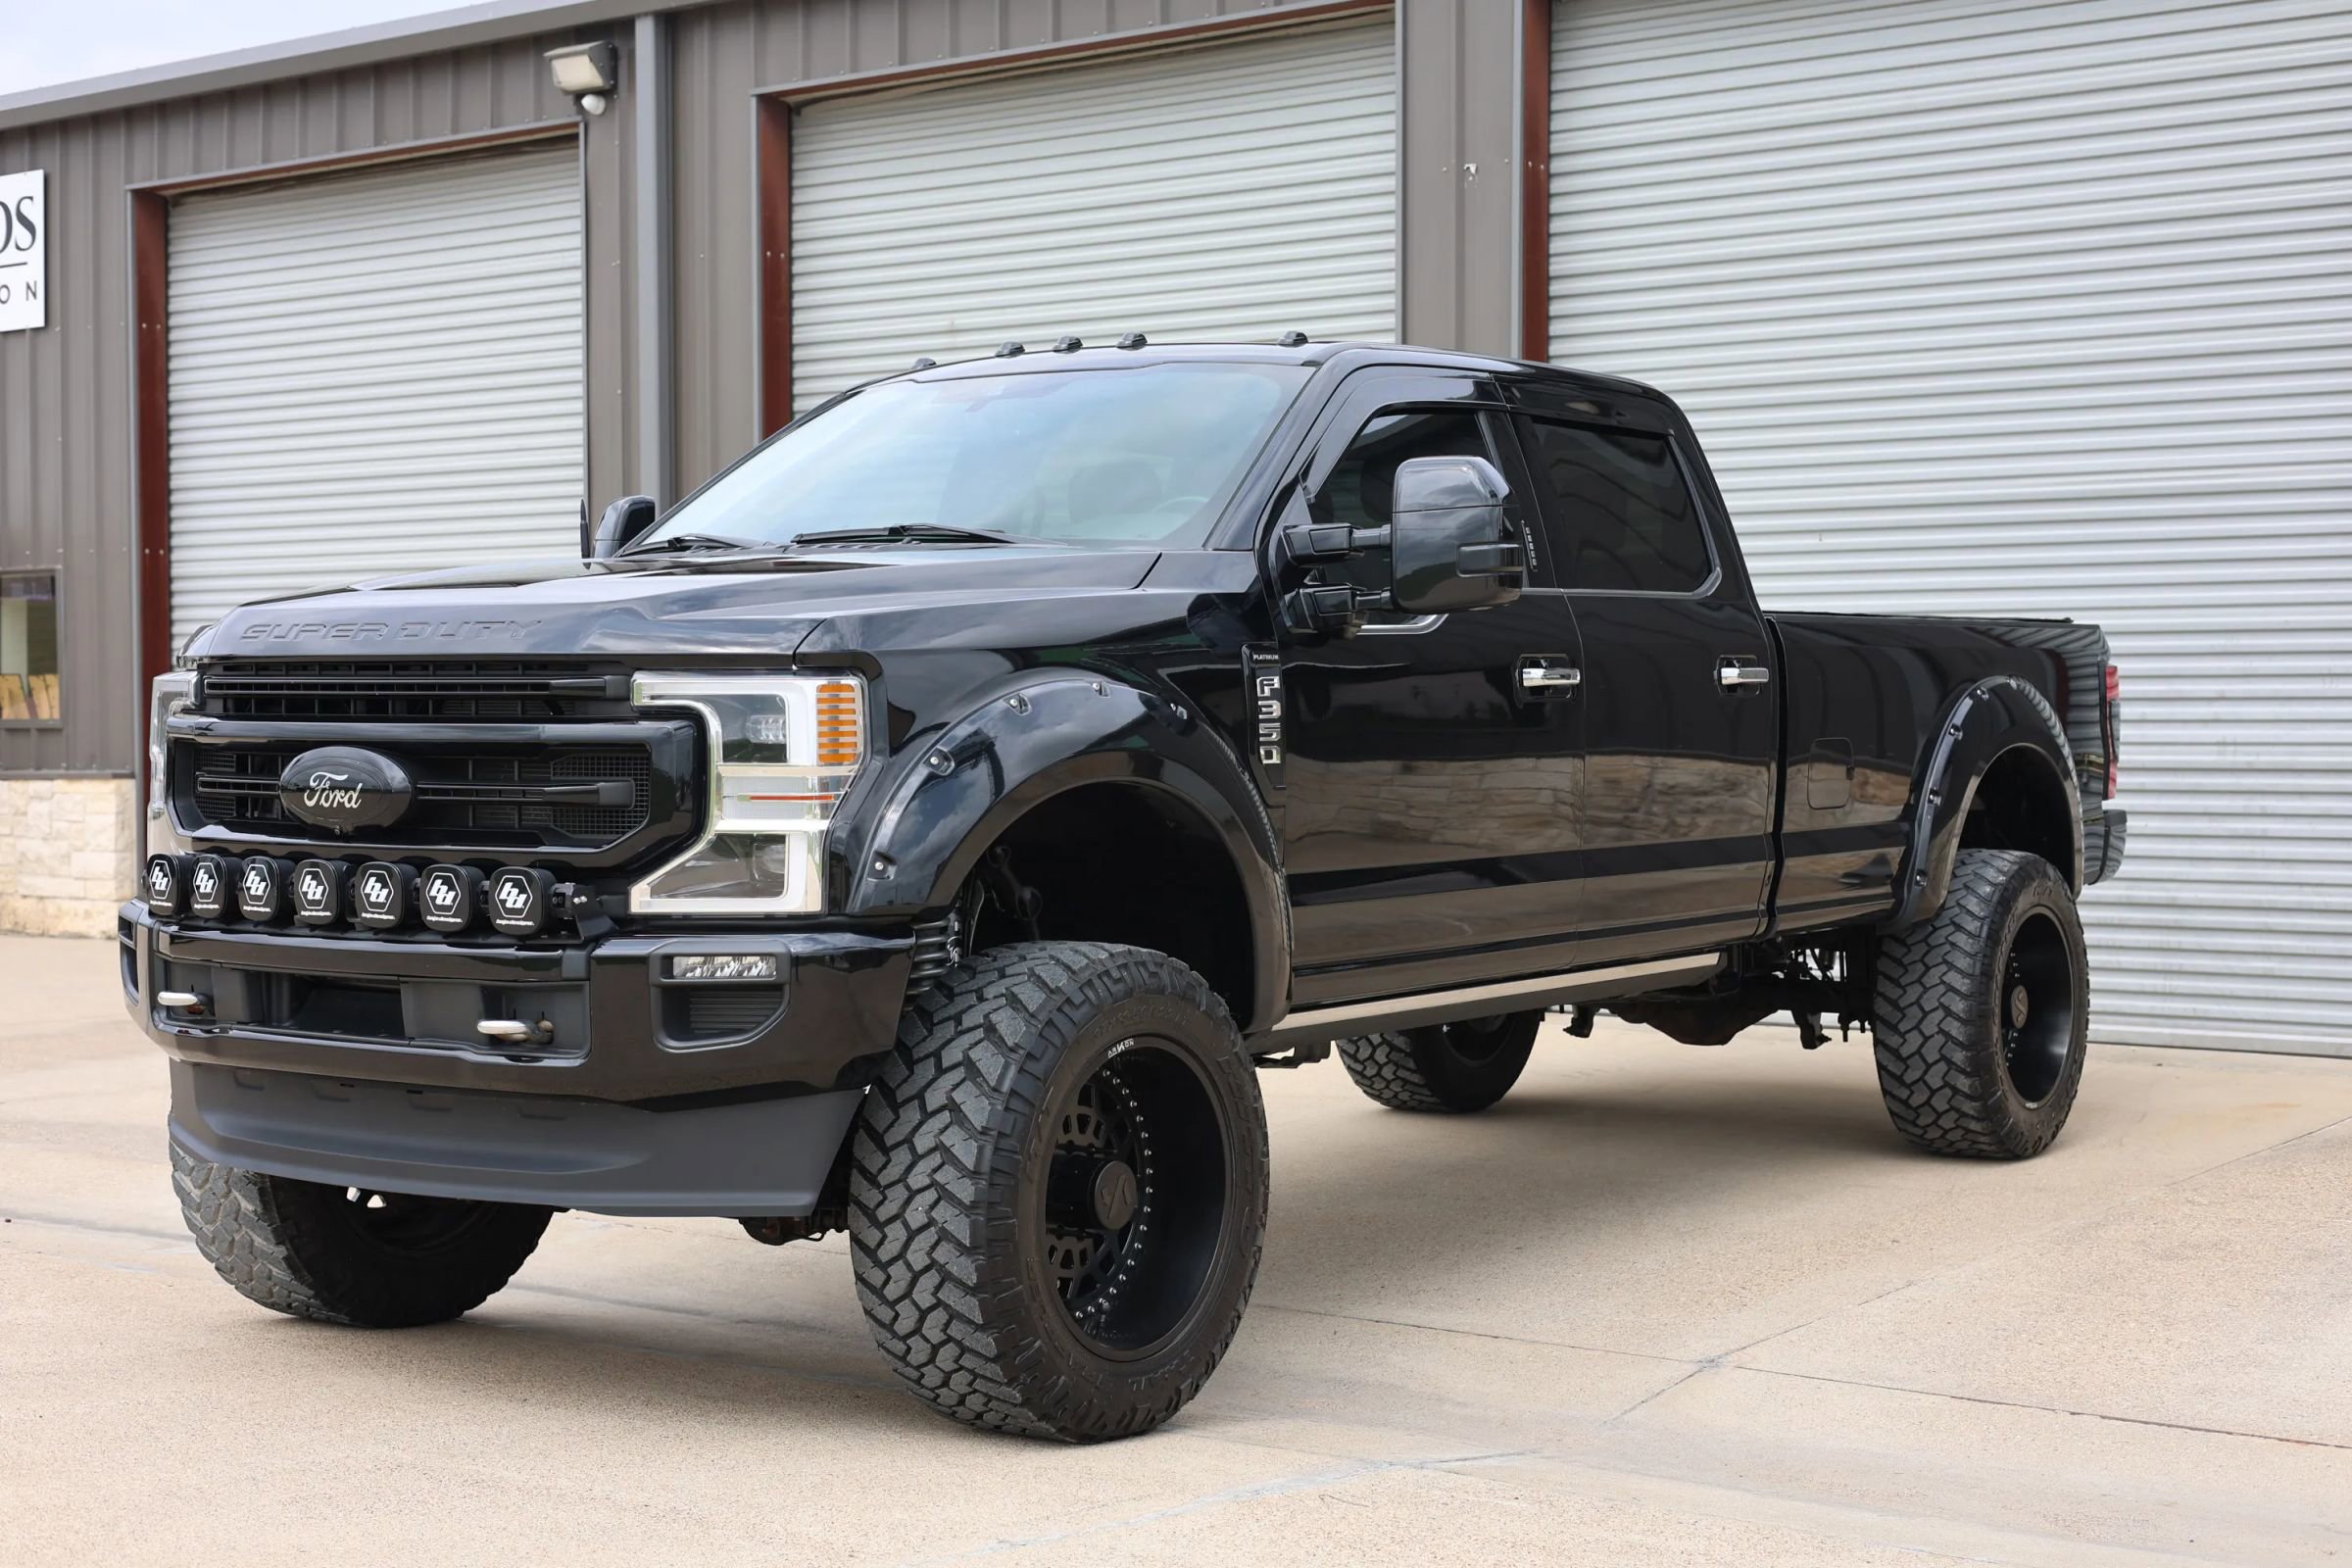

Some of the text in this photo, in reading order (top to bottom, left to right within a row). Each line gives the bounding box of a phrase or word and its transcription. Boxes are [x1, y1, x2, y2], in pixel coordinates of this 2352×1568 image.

[240, 620, 542, 641] SUPER DUTY
[1256, 676, 1282, 764] F350
[304, 771, 364, 808] Ford
